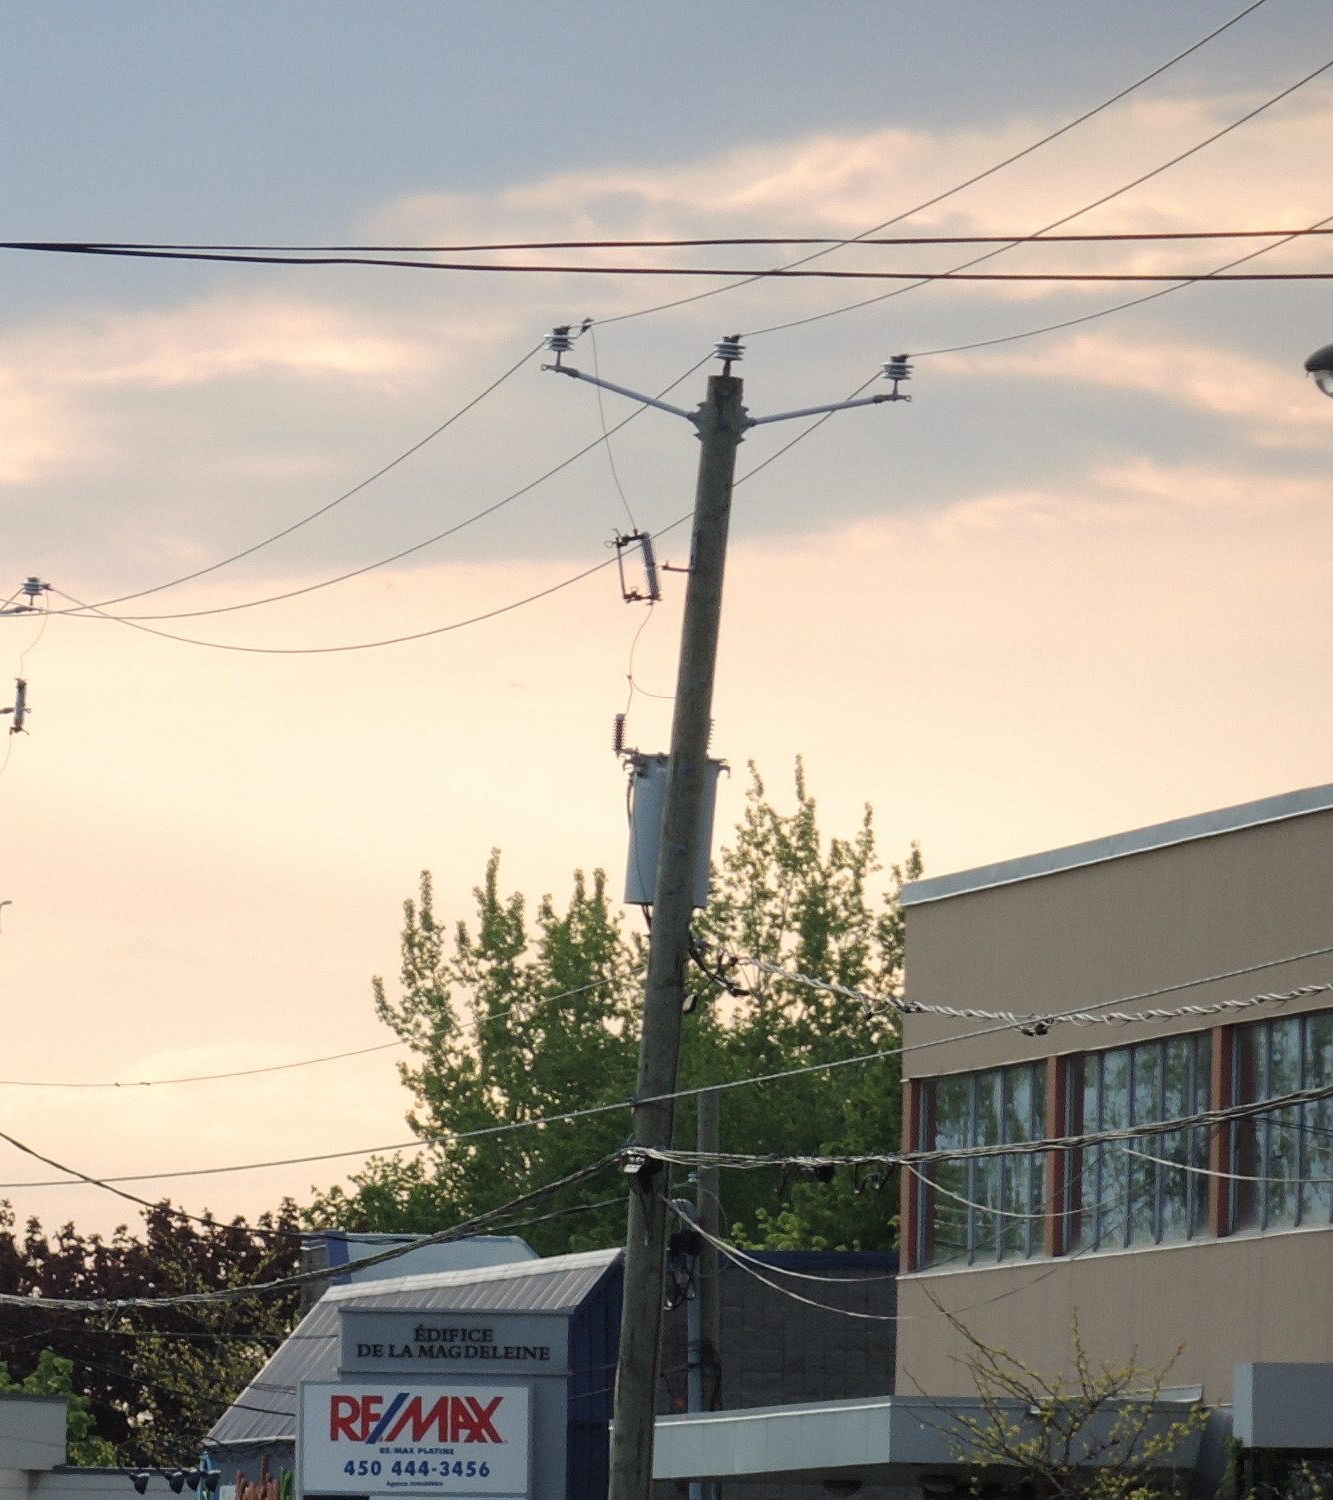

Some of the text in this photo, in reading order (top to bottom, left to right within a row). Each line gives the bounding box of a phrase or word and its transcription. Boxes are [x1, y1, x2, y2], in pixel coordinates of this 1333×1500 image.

[414, 1324, 493, 1343] ÉDIFICE
[357, 1344, 551, 1361] DE LA MAGDELEINE
[330, 1393, 505, 1444] RE/MAX
[344, 1460, 490, 1478] 450 444-3456
